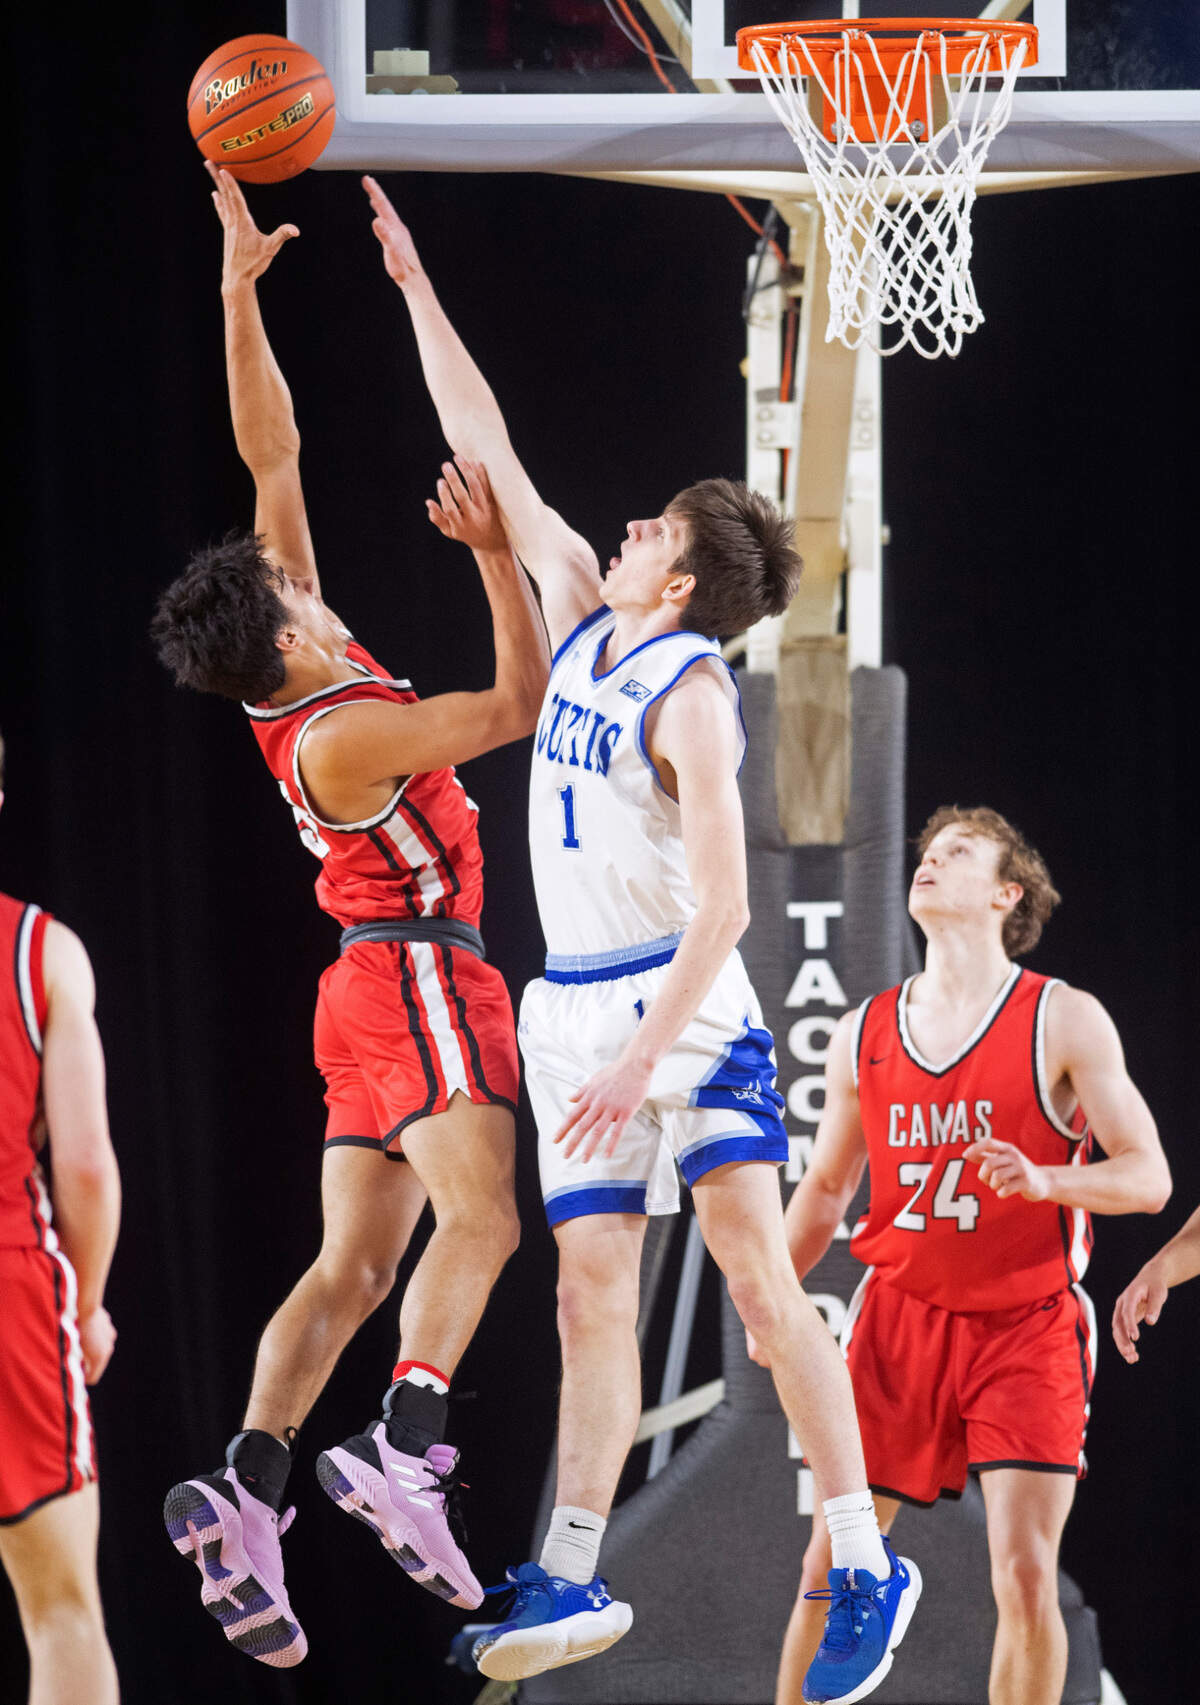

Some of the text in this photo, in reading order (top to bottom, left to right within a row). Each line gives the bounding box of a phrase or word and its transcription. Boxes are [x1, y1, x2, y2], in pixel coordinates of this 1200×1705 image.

[204, 59, 288, 116] Baden
[557, 782, 582, 851] 1
[784, 901, 850, 1240] TACO
[887, 1099, 993, 1148] CAMAS
[892, 1158, 980, 1232] 24
